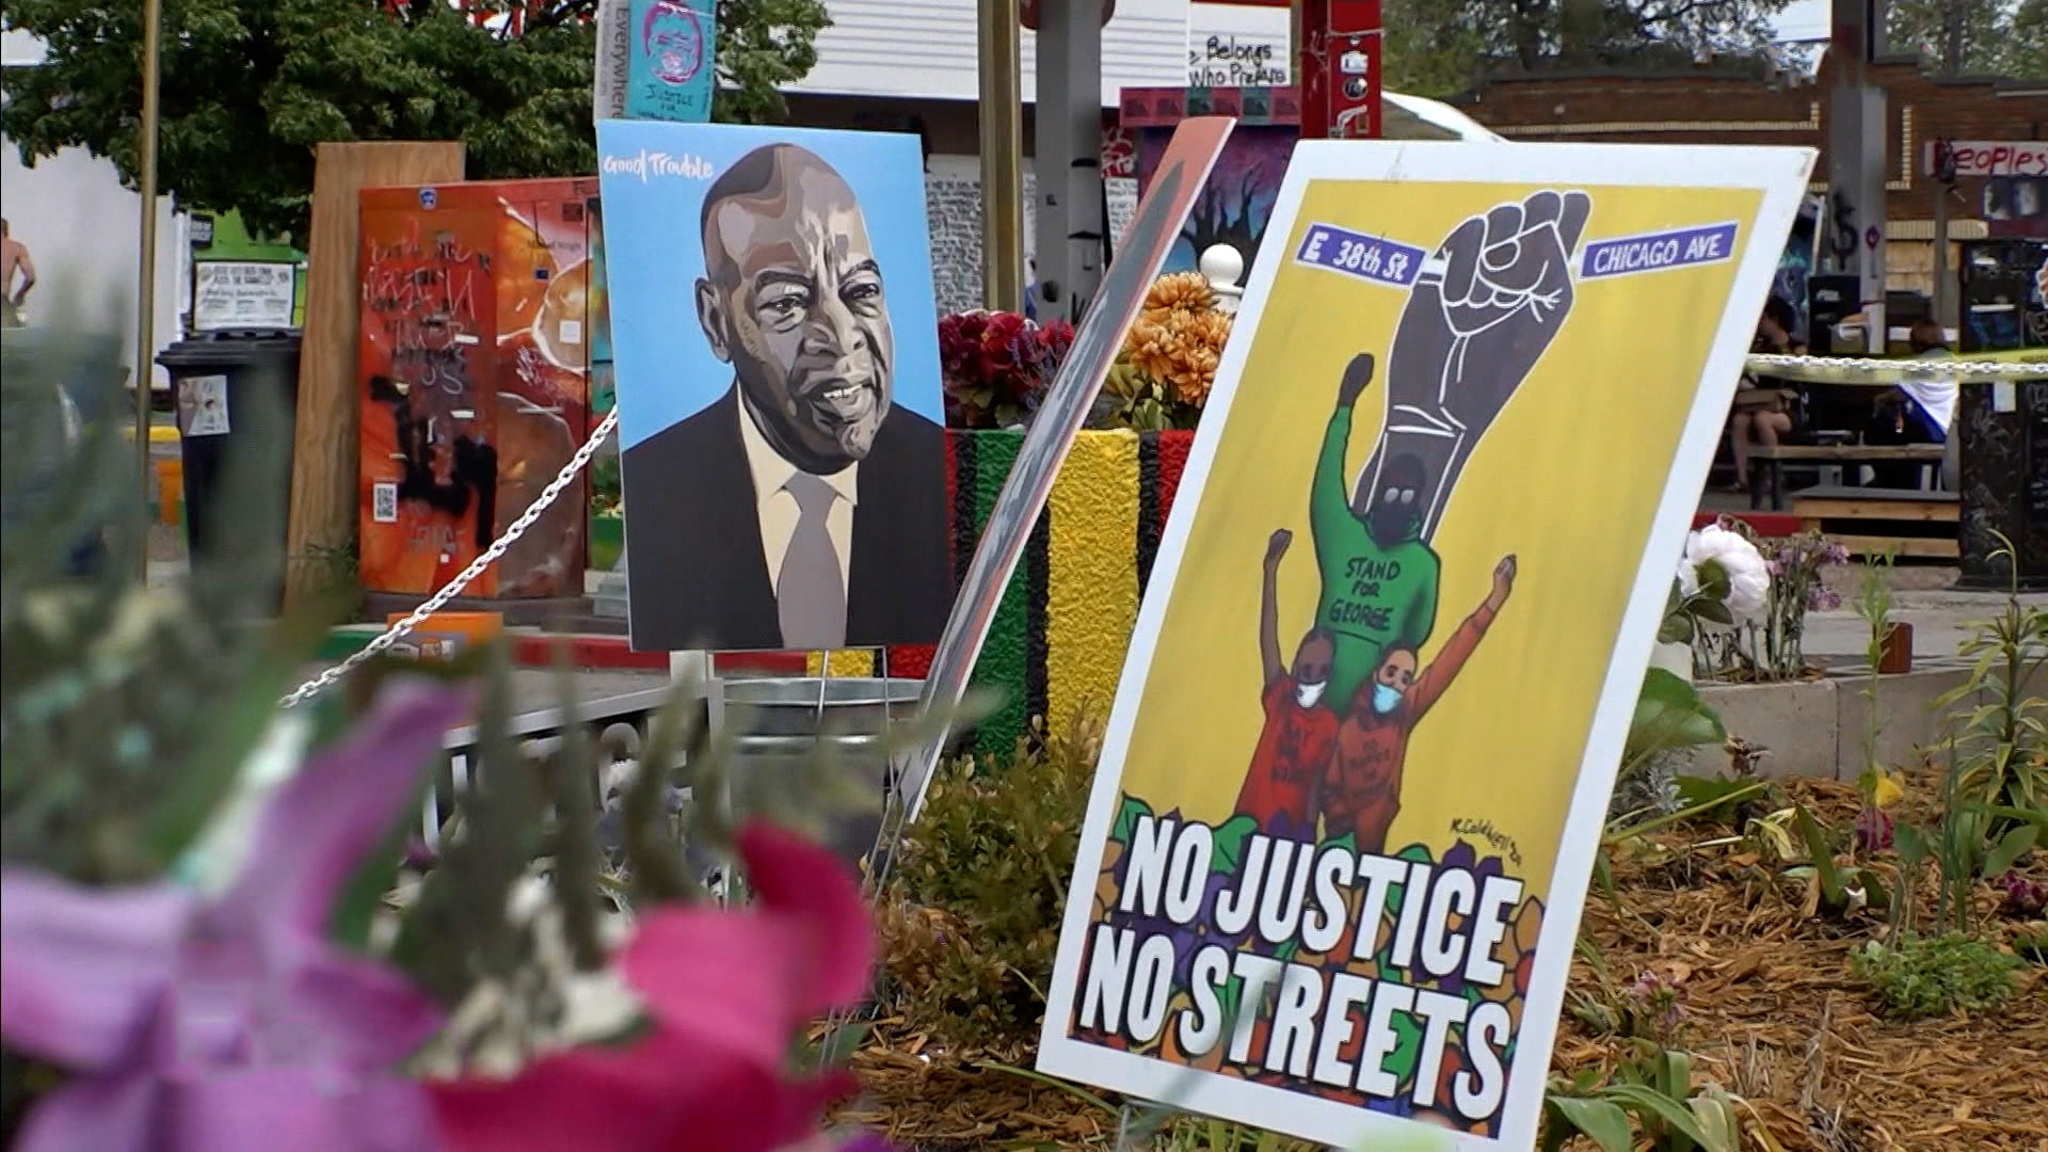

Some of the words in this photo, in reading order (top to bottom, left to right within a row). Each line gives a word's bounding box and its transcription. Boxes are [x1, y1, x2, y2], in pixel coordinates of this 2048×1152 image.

[1206, 35, 1272, 68] Belongs
[1189, 65, 1225, 87] Who
[604, 149, 648, 184] Good
[648, 152, 714, 180] Trouble
[1303, 230, 1330, 263] E
[1332, 240, 1382, 276] 38th
[1382, 251, 1409, 281] St
[1593, 238, 1679, 274] CHICAGO
[1684, 233, 1724, 261] AVE
[1344, 556, 1402, 581] STAND
[1351, 580, 1381, 598] FOR
[1329, 598, 1394, 632] GEORGE
[1120, 814, 1213, 925] NO
[1215, 833, 1524, 986] JUSTICE
[1079, 923, 1175, 1043] NO
[1178, 945, 1511, 1121] STREETS
